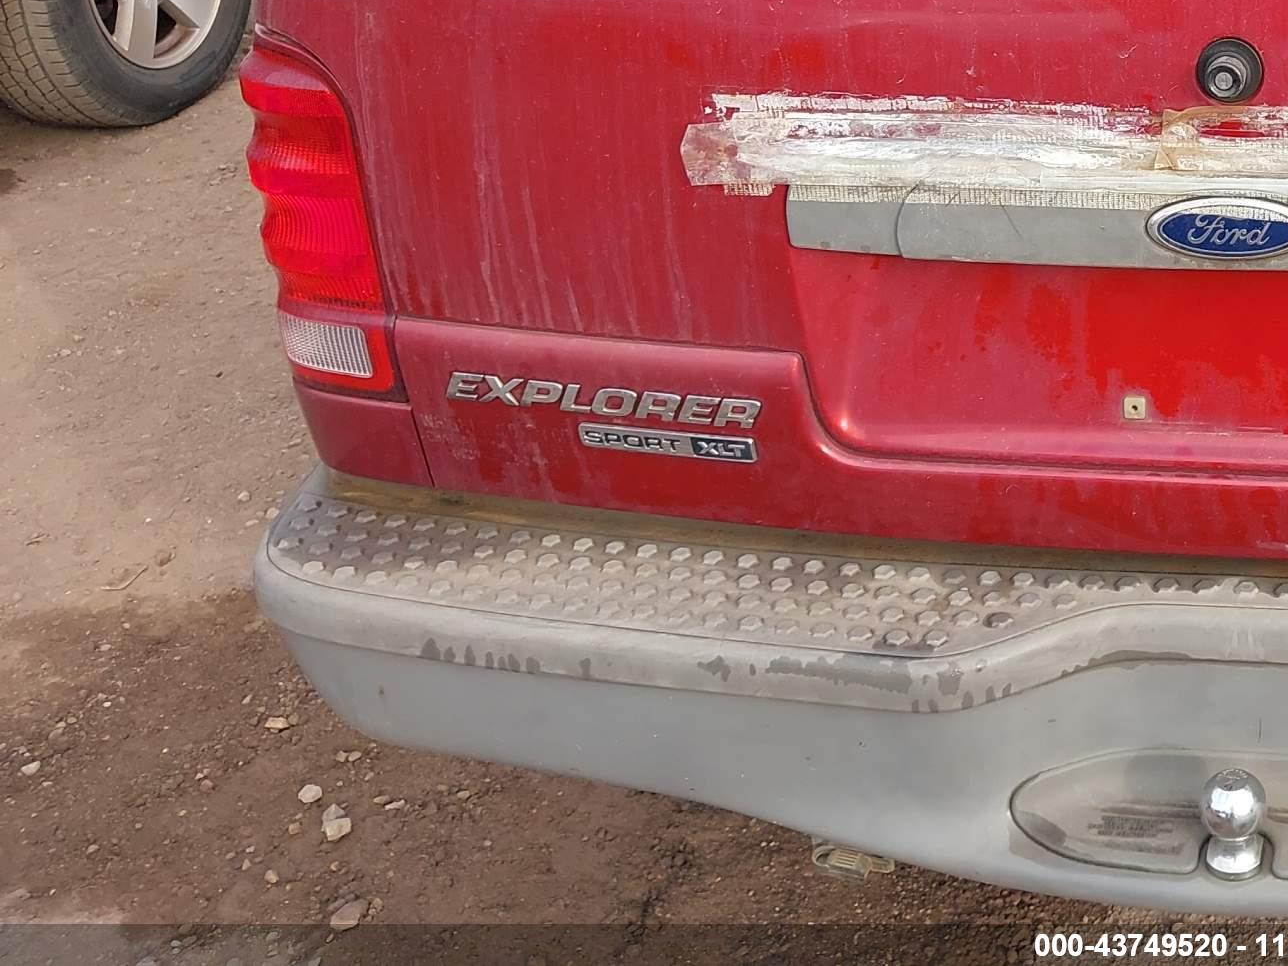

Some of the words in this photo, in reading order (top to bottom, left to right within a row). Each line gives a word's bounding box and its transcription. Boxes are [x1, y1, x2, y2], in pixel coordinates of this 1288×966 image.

[1187, 214, 1271, 246] Ford
[446, 371, 762, 428] EXPLORER
[583, 430, 681, 453] SPORT
[697, 440, 746, 458] XLT
